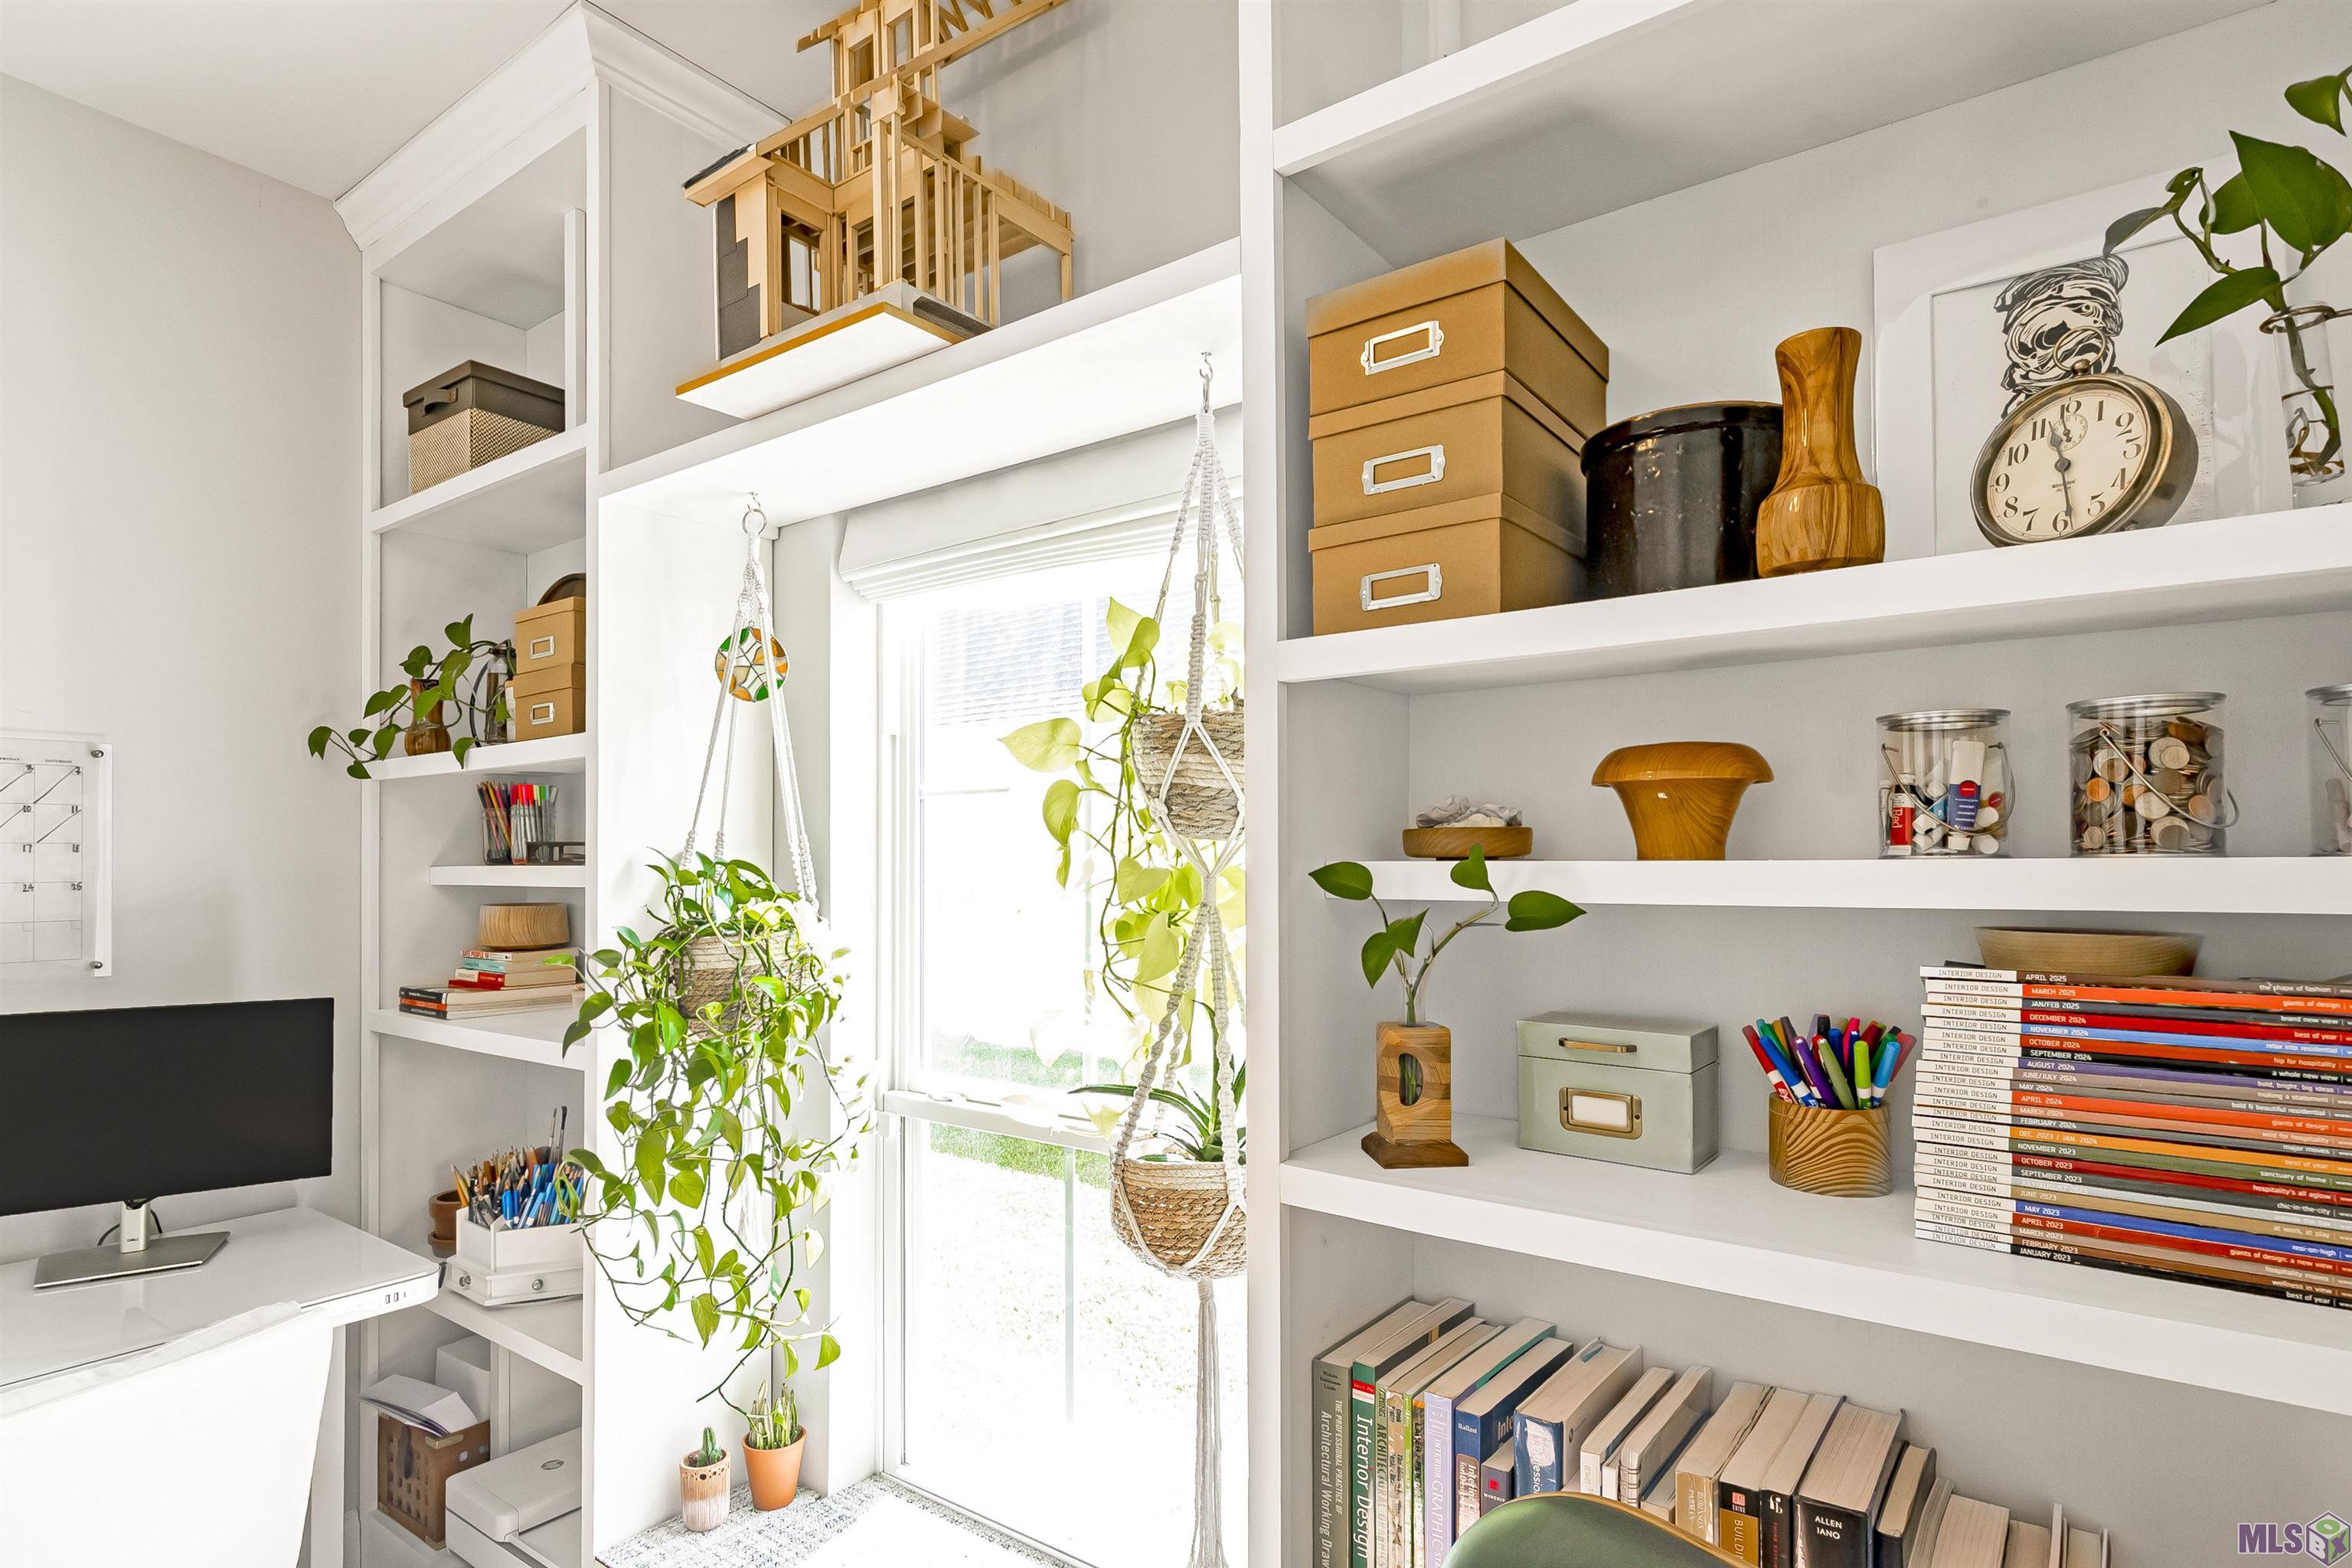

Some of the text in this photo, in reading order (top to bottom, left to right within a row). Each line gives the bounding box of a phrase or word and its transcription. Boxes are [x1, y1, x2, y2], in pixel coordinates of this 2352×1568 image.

[2097, 400, 2104, 421] 1
[2031, 418, 2046, 442] 11
[2115, 412, 2134, 438] 2
[2007, 443, 2029, 466] 10
[1995, 473, 2010, 493] 9
[2111, 468, 2126, 490] 4
[2004, 496, 2018, 518] 8
[2087, 492, 2105, 516] 5
[2023, 507, 2040, 531] 7
[2052, 511, 2068, 533] 6
[1892, 808, 1903, 828] Red
[23, 844, 32, 853] 17
[2031, 1001, 2060, 1009] JAN/FEB
[2030, 1014, 2067, 1023] DECEMBER
[2030, 1026, 2068, 1034] NOVEMBER
[1940, 1054, 1974, 1062] INTERIOR
[1942, 1032, 1976, 1040] INTERIOR
[2030, 1038, 2060, 1047] OCTOBER
[2298, 1059, 2336, 1068] hospitality
[2030, 1050, 2071, 1059] SEPTEMBER
[2074, 1053, 2092, 1061] 2024
[1932, 1076, 1965, 1084] INTERIOR
[1935, 1064, 1968, 1073] INTERIOR
[2022, 1072, 2057, 1080] JUNE/JULY
[1934, 1086, 1968, 1096] INTERIOR
[1932, 1099, 1966, 1107] INTERIOR
[1932, 1121, 1965, 1130] INTERIOR
[1968, 1125, 1996, 1133] DESIGN
[1933, 1109, 1967, 1118] INTERIOR
[1969, 1112, 1997, 1121] DESIGN
[2020, 1118, 2057, 1127] FEBRUARY
[1930, 1133, 1964, 1142] INTERIOR
[1967, 1137, 1994, 1145] DESIGN
[2018, 1143, 2056, 1153] NOVEMBER
[1934, 1148, 1968, 1157] INTERIOR
[1971, 1152, 1998, 1160] DESIGN
[2021, 1158, 2053, 1167] OCTOBER
[1933, 1158, 2082, 1183] INTERIOR DESIGN SEPTEMBER 2023
[1932, 1178, 2057, 1200] INTERIOR DESIGN JUNE 2023
[1937, 1192, 1971, 1202] INTERIOR
[1974, 1197, 2001, 1207] DESIGN
[1934, 1204, 1968, 1214] INTERIOR
[1971, 1210, 1998, 1219] DESIGN
[2022, 1217, 2043, 1227] APRIL
[1932, 1214, 2063, 1240] INTERIOR DESIGN MARCH 2023
[2022, 1240, 2058, 1250] FEBRUARY
[1932, 1233, 1966, 1244] INTERIOR
[1968, 1240, 1996, 1249] DESIGN
[2020, 1248, 2051, 1258] JANUARY
[2053, 1253, 2071, 1262] 2023
[2286, 1292, 2302, 1300] best
[1458, 1423, 1478, 1435] Ballast
[1321, 1410, 1332, 1487] Architectural
[1357, 1414, 1373, 1490] Interior
[1432, 1439, 1442, 1479] INTERIOR
[1319, 1489, 1332, 1537] Working
[1335, 1505, 1343, 1515] OF
[1432, 1481, 1444, 1551] GRAPHIC
[1352, 1494, 1373, 1559] Design
[1815, 1516, 1842, 1529] ALLEN
[1817, 1527, 1840, 1539] IANO
